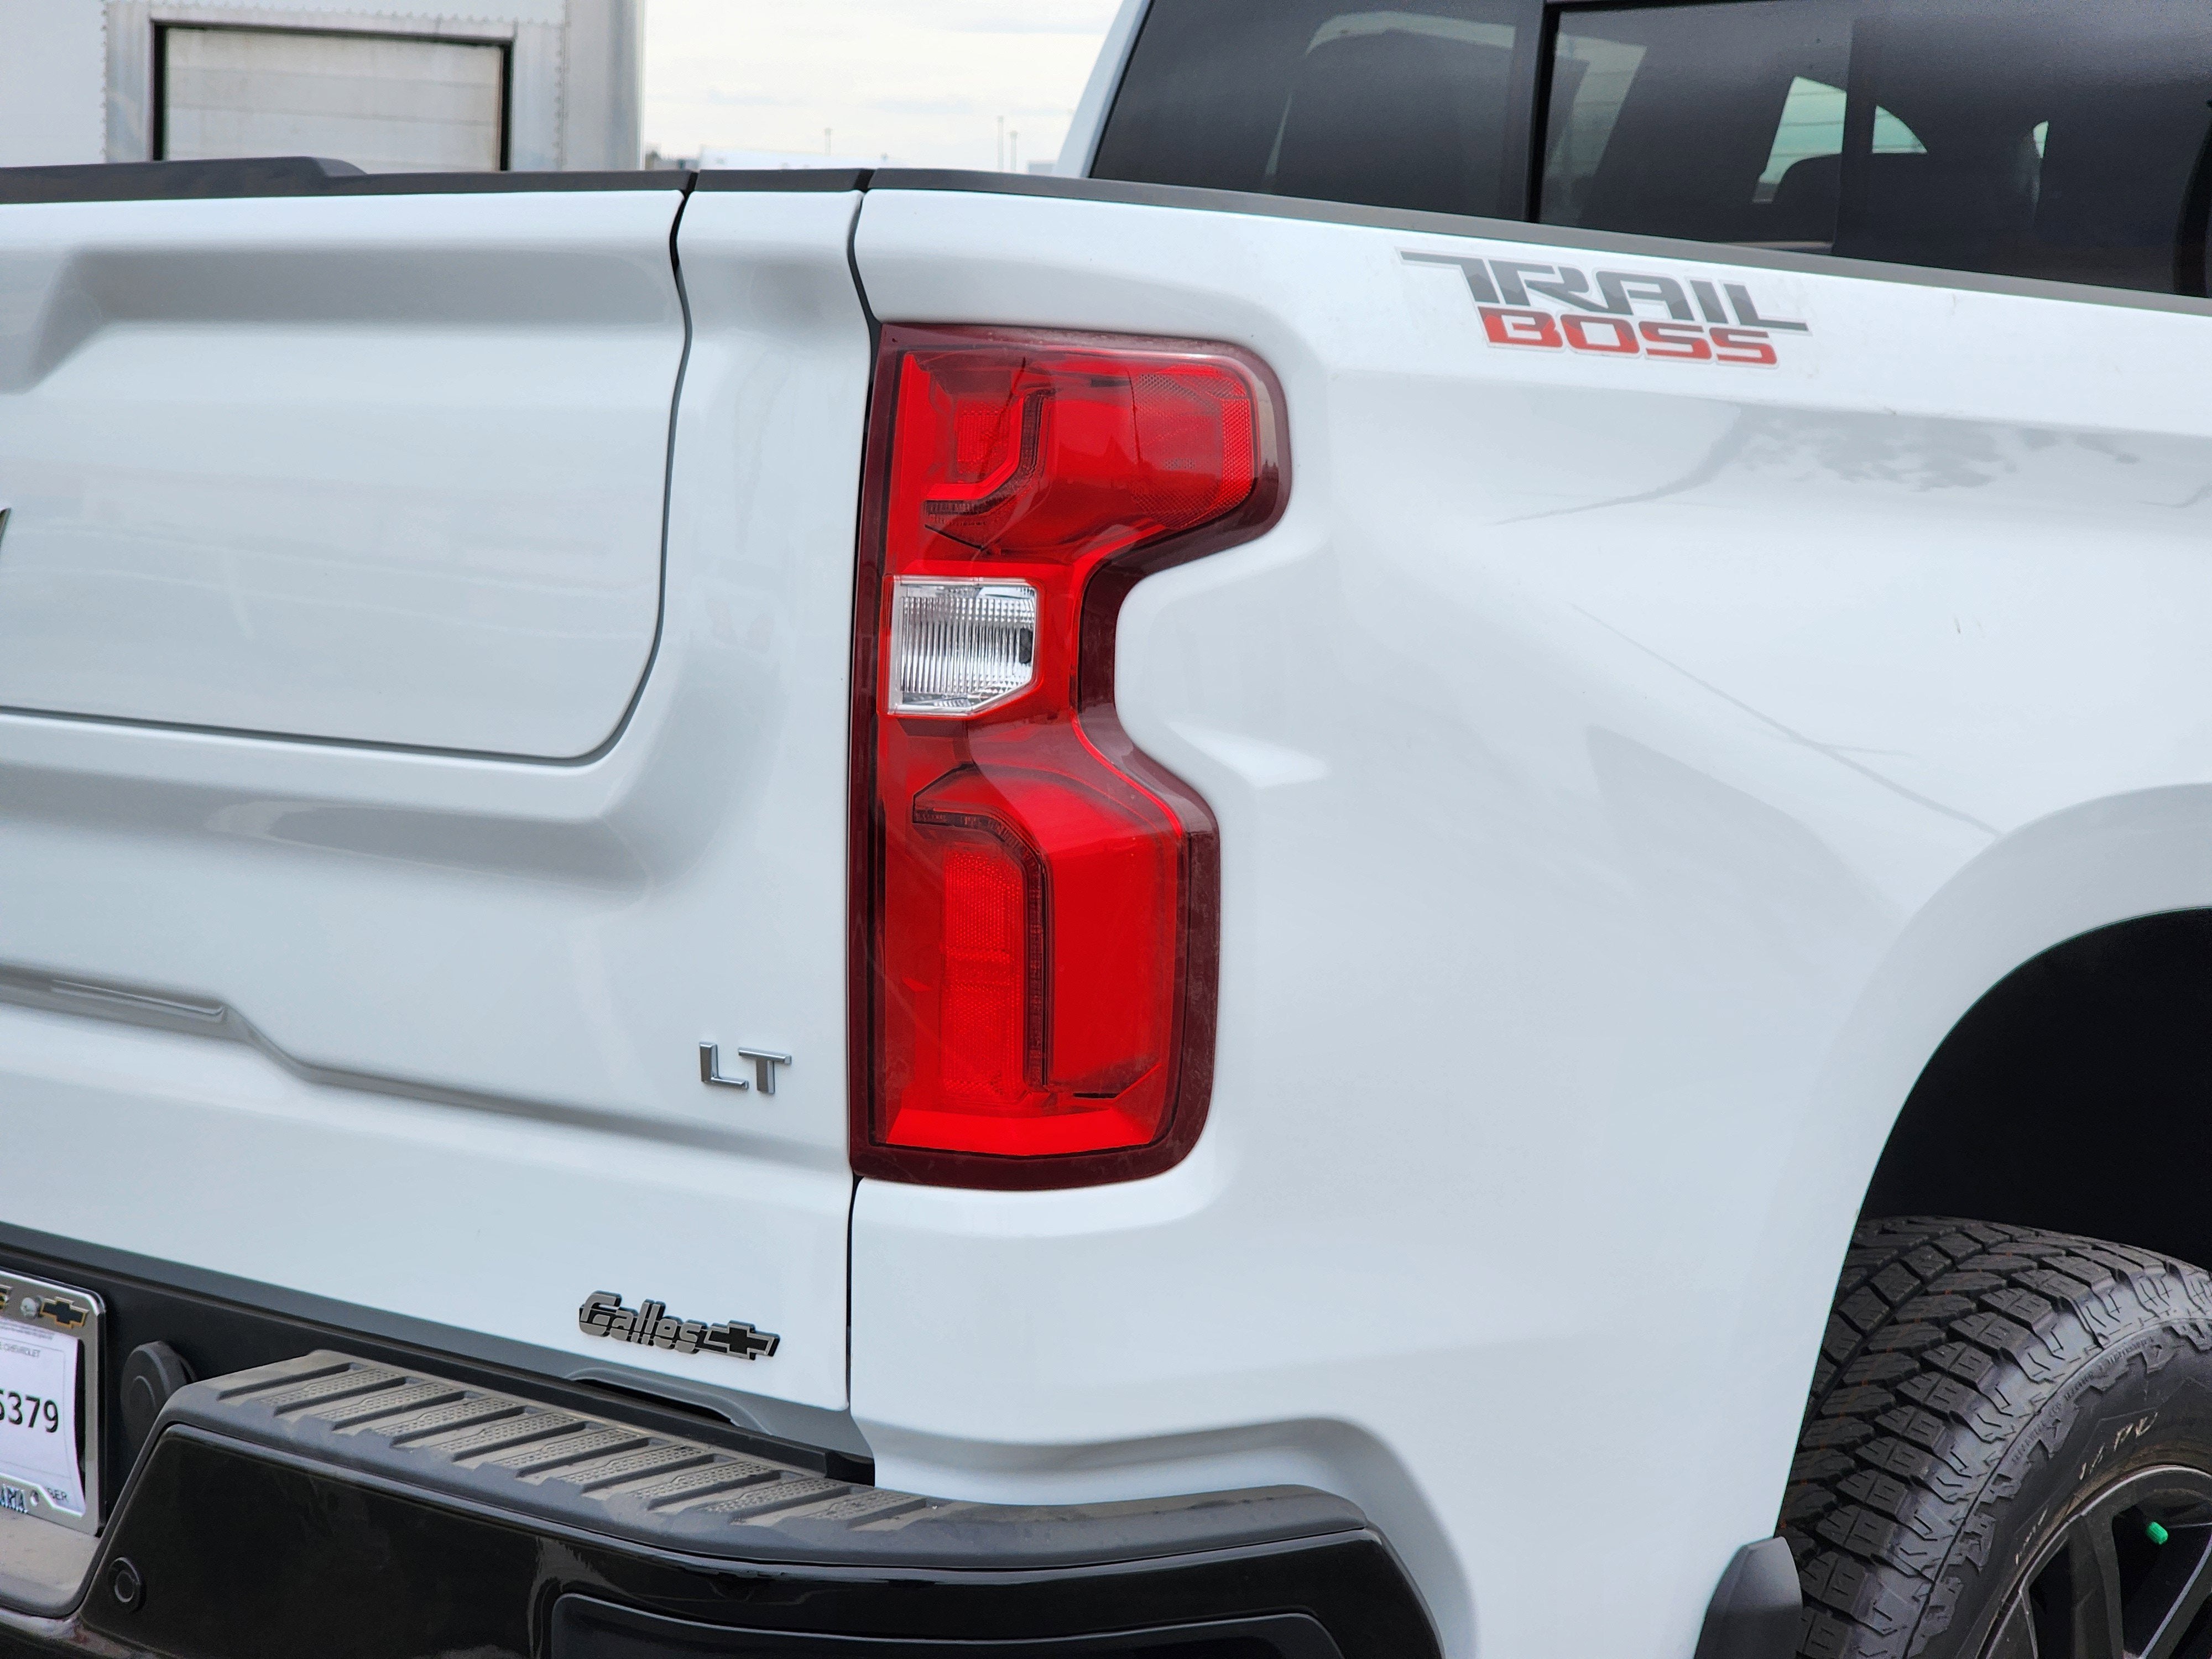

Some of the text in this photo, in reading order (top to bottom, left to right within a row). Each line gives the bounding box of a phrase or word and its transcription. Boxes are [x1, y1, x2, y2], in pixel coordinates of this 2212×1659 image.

[1399, 250, 1809, 332] TRAIL
[1477, 306, 1777, 365] BOSS
[699, 1041, 792, 1095] LT
[579, 1290, 708, 1354] Galles
